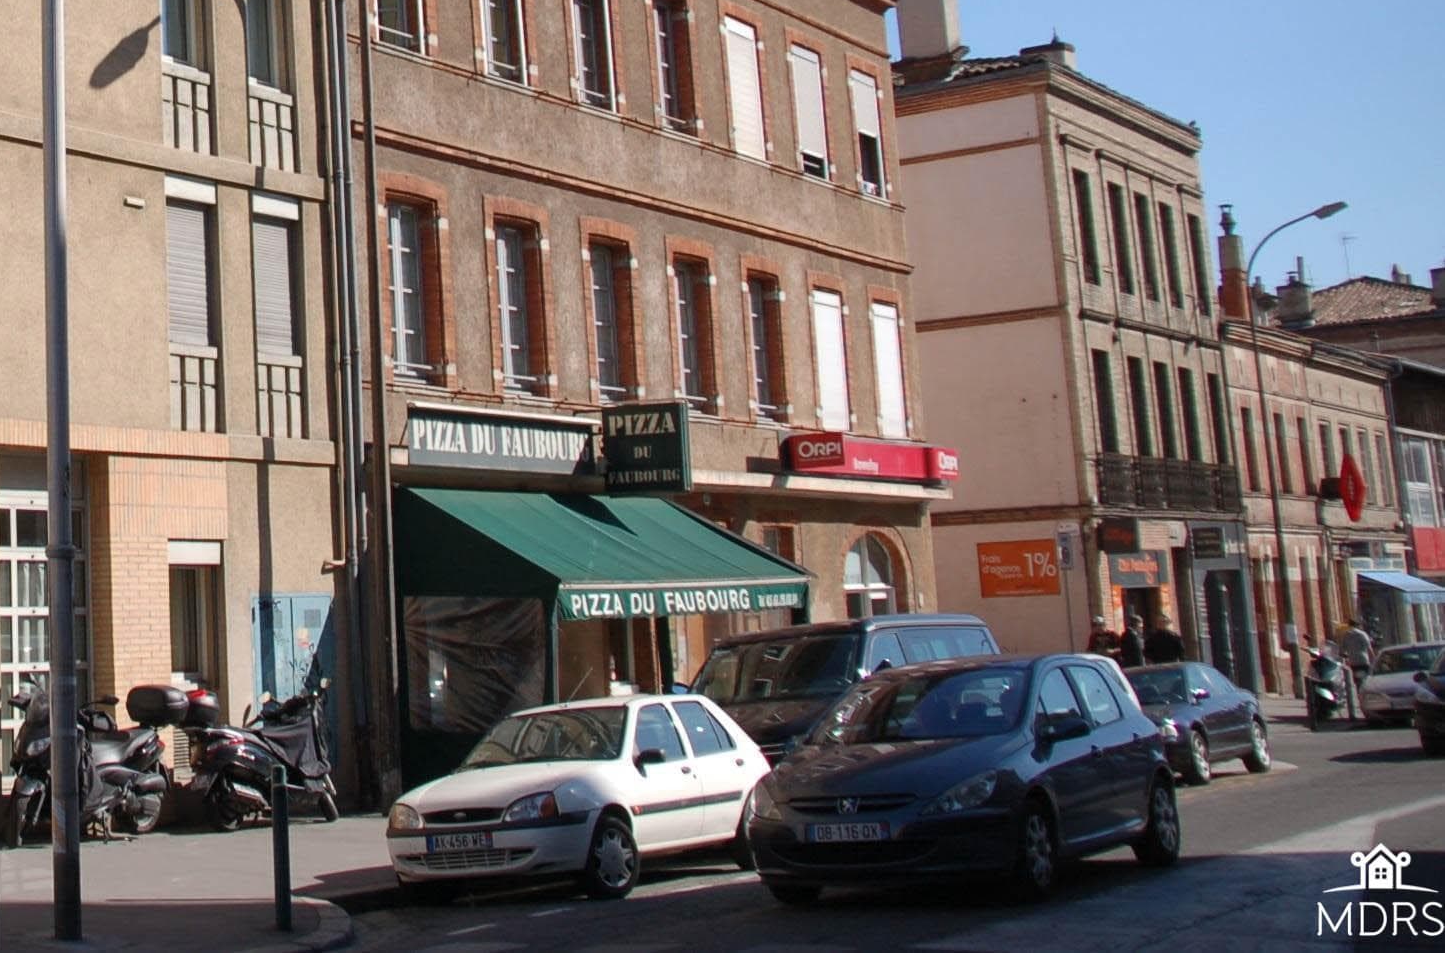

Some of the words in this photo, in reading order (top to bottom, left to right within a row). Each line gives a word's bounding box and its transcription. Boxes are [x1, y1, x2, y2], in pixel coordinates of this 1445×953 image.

[608, 412, 676, 437] PIZZA
[412, 418, 467, 454] PIZZA
[471, 423, 496, 455] DU
[501, 426, 590, 462] FAUBOURG
[634, 445, 652, 459] DU
[798, 441, 842, 458] ORPI
[609, 469, 681, 484] FAUBOURG
[1022, 551, 1057, 577] 1%
[570, 593, 624, 617] PIZZA
[629, 593, 654, 615] DU
[663, 588, 750, 614] FAUBOURG
